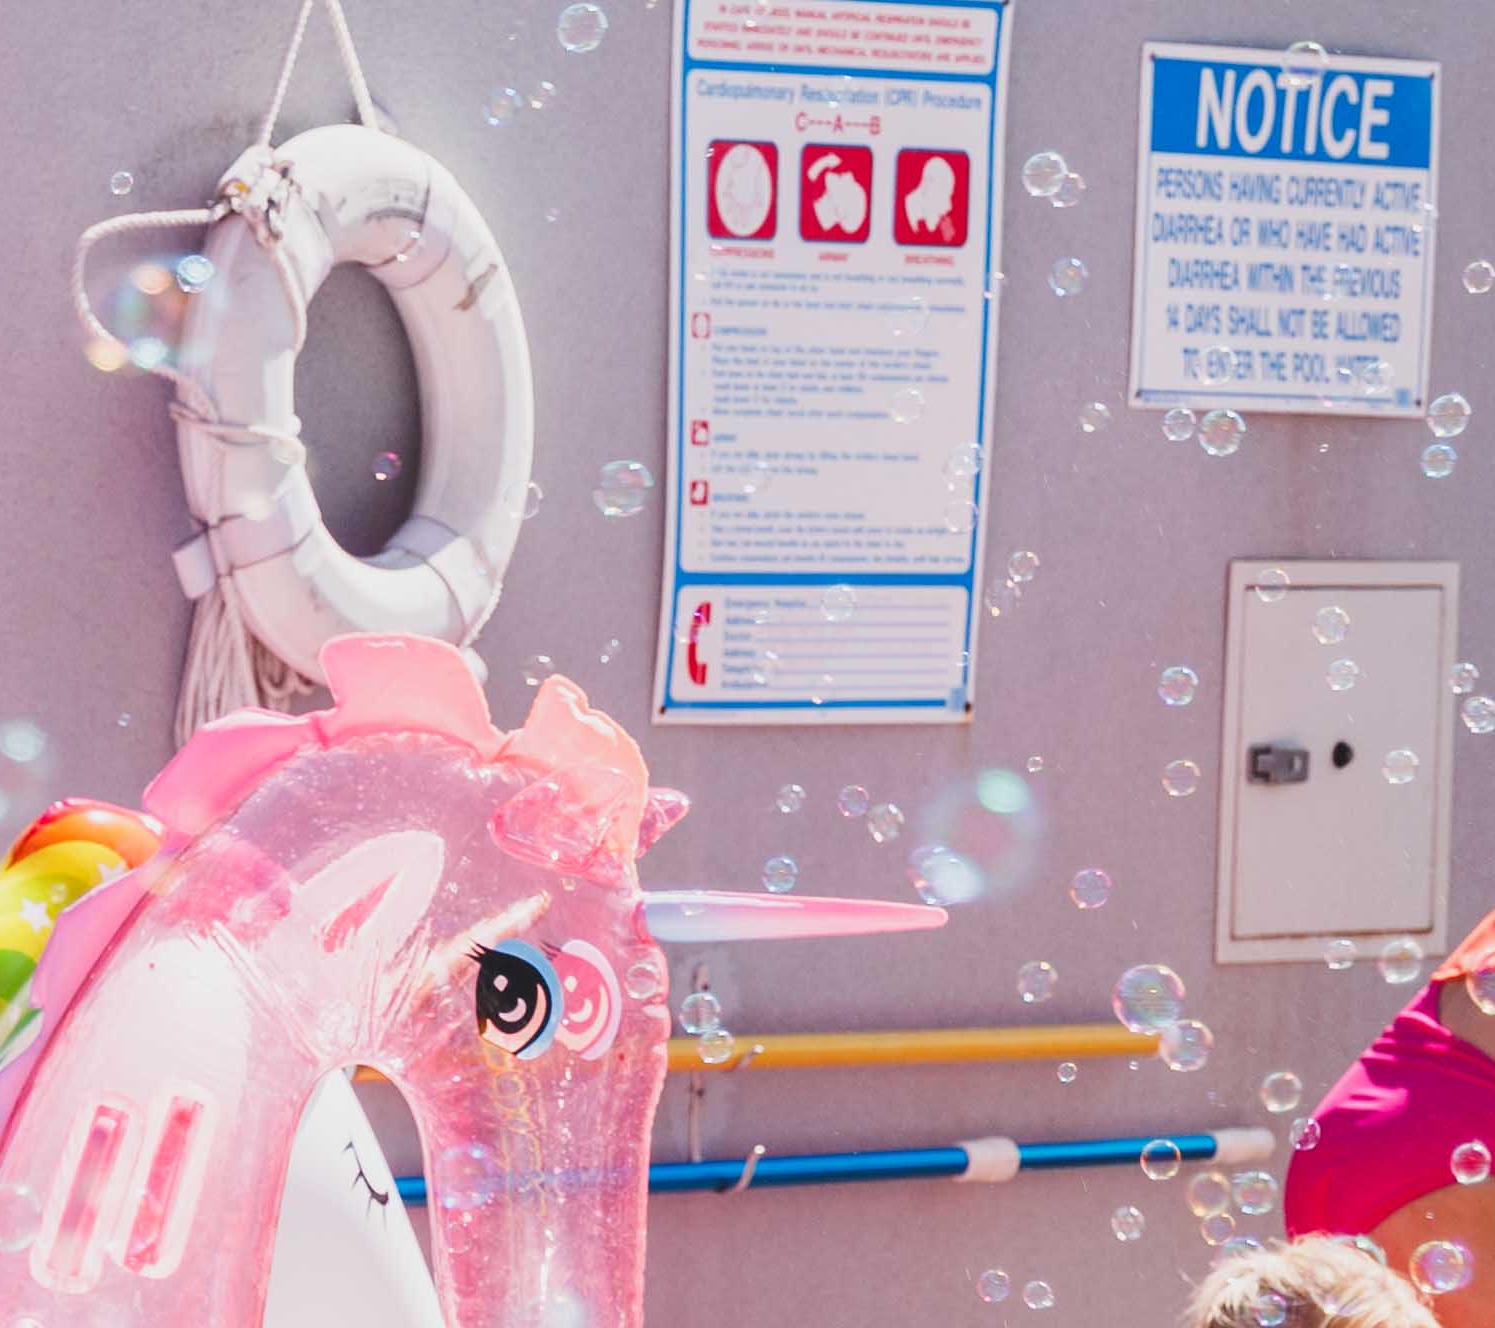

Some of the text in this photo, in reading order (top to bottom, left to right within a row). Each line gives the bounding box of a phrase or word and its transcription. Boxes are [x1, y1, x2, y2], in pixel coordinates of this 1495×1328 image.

[1196, 68, 1394, 159] NOTICE
[1157, 168, 1223, 200] PERSONS
[1229, 172, 1281, 204] HAVING
[1373, 180, 1420, 213] ACTIVE
[1258, 220, 1289, 248] WHO
[1296, 222, 1332, 251] HAVE
[1338, 224, 1365, 253] HAD
[1373, 225, 1420, 257] ACTIVE
[1247, 262, 1294, 293] WITHIN
[1301, 265, 1327, 295] THE
[1185, 304, 1221, 334] DAYS
[1229, 305, 1272, 337] SHALL
[1278, 308, 1306, 337] NOT
[1312, 309, 1329, 340] BE
[1336, 312, 1399, 342] ALLOWED
[1260, 351, 1286, 382] THE
[1294, 353, 1330, 384] POOL
